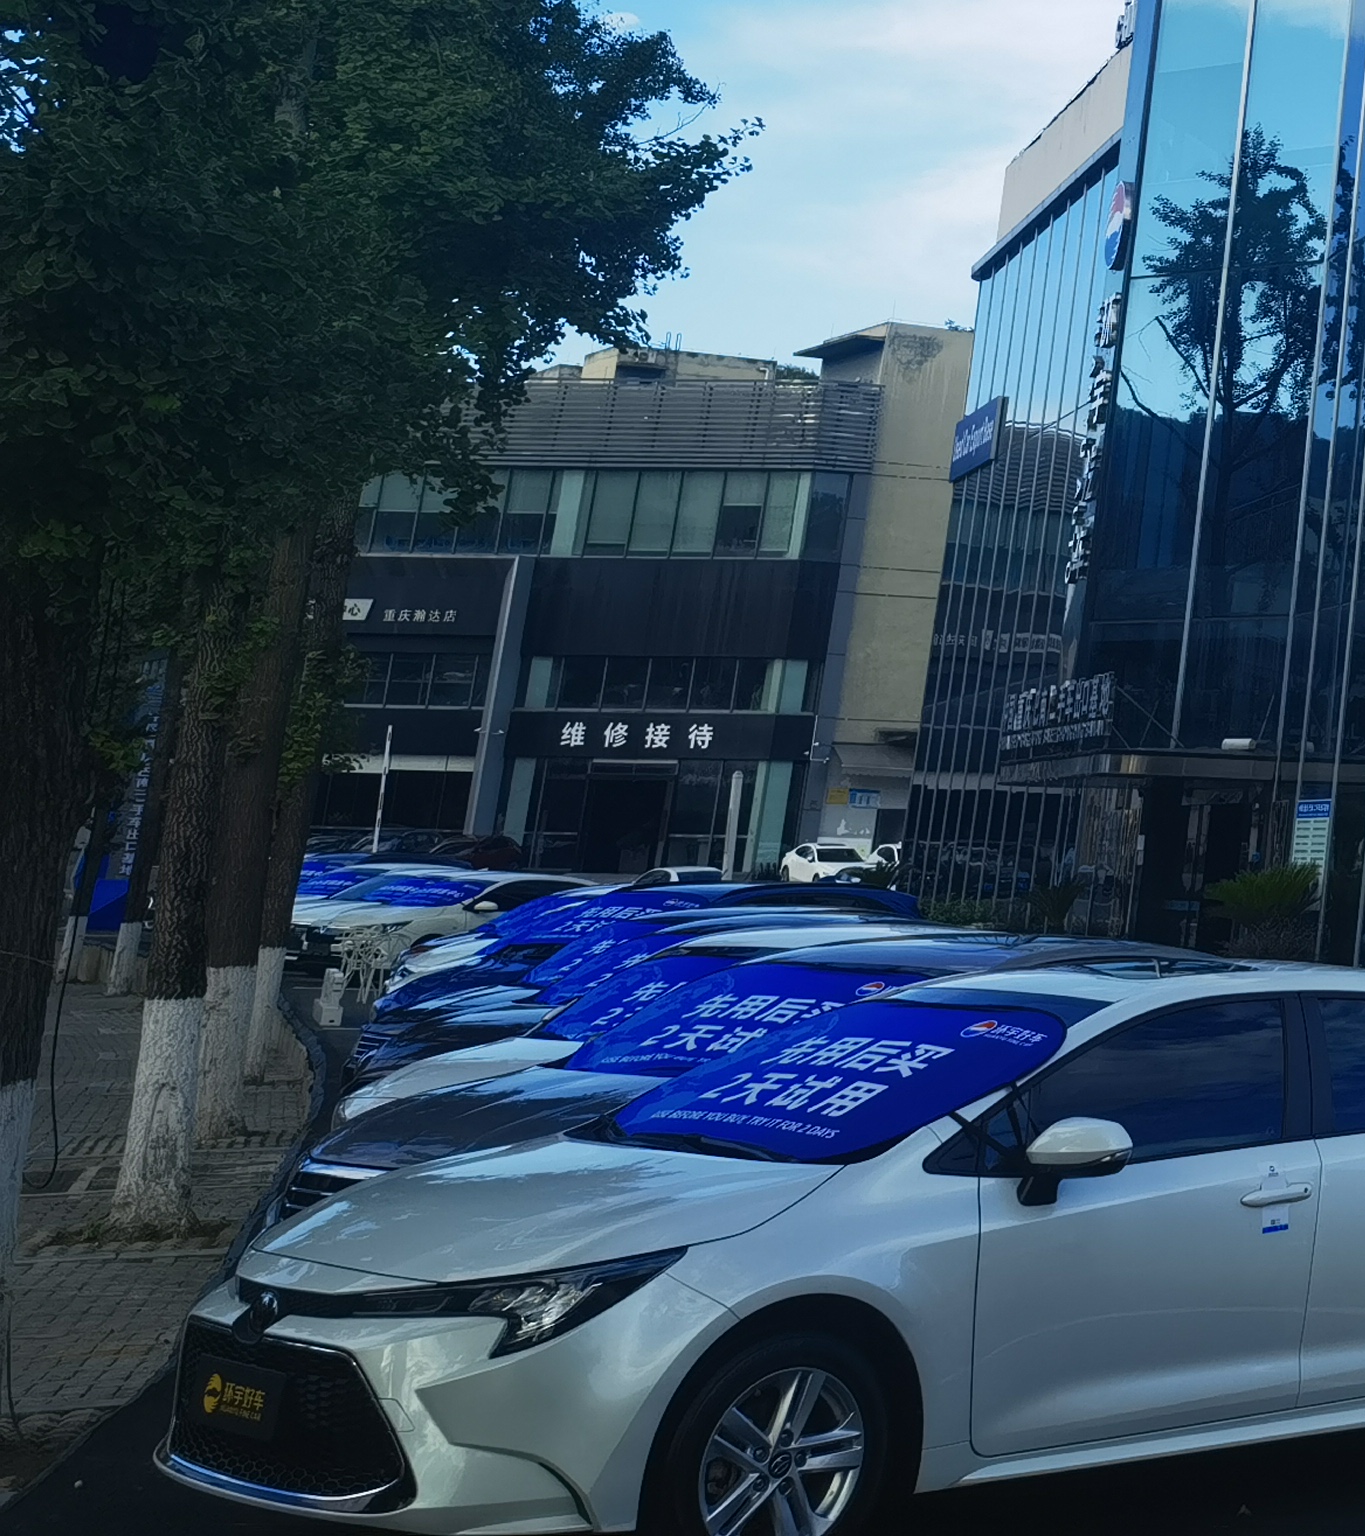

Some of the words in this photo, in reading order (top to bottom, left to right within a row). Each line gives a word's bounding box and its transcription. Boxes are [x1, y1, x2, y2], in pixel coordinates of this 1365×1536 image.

[560, 721, 714, 749] 维修接待
[760, 1036, 956, 1079] 先用后买
[698, 1072, 890, 1118] 2天试用
[776, 1120, 804, 1133] FOR
[805, 1125, 841, 1140] DAYS
[222, 1381, 267, 1411] 环宇好车
